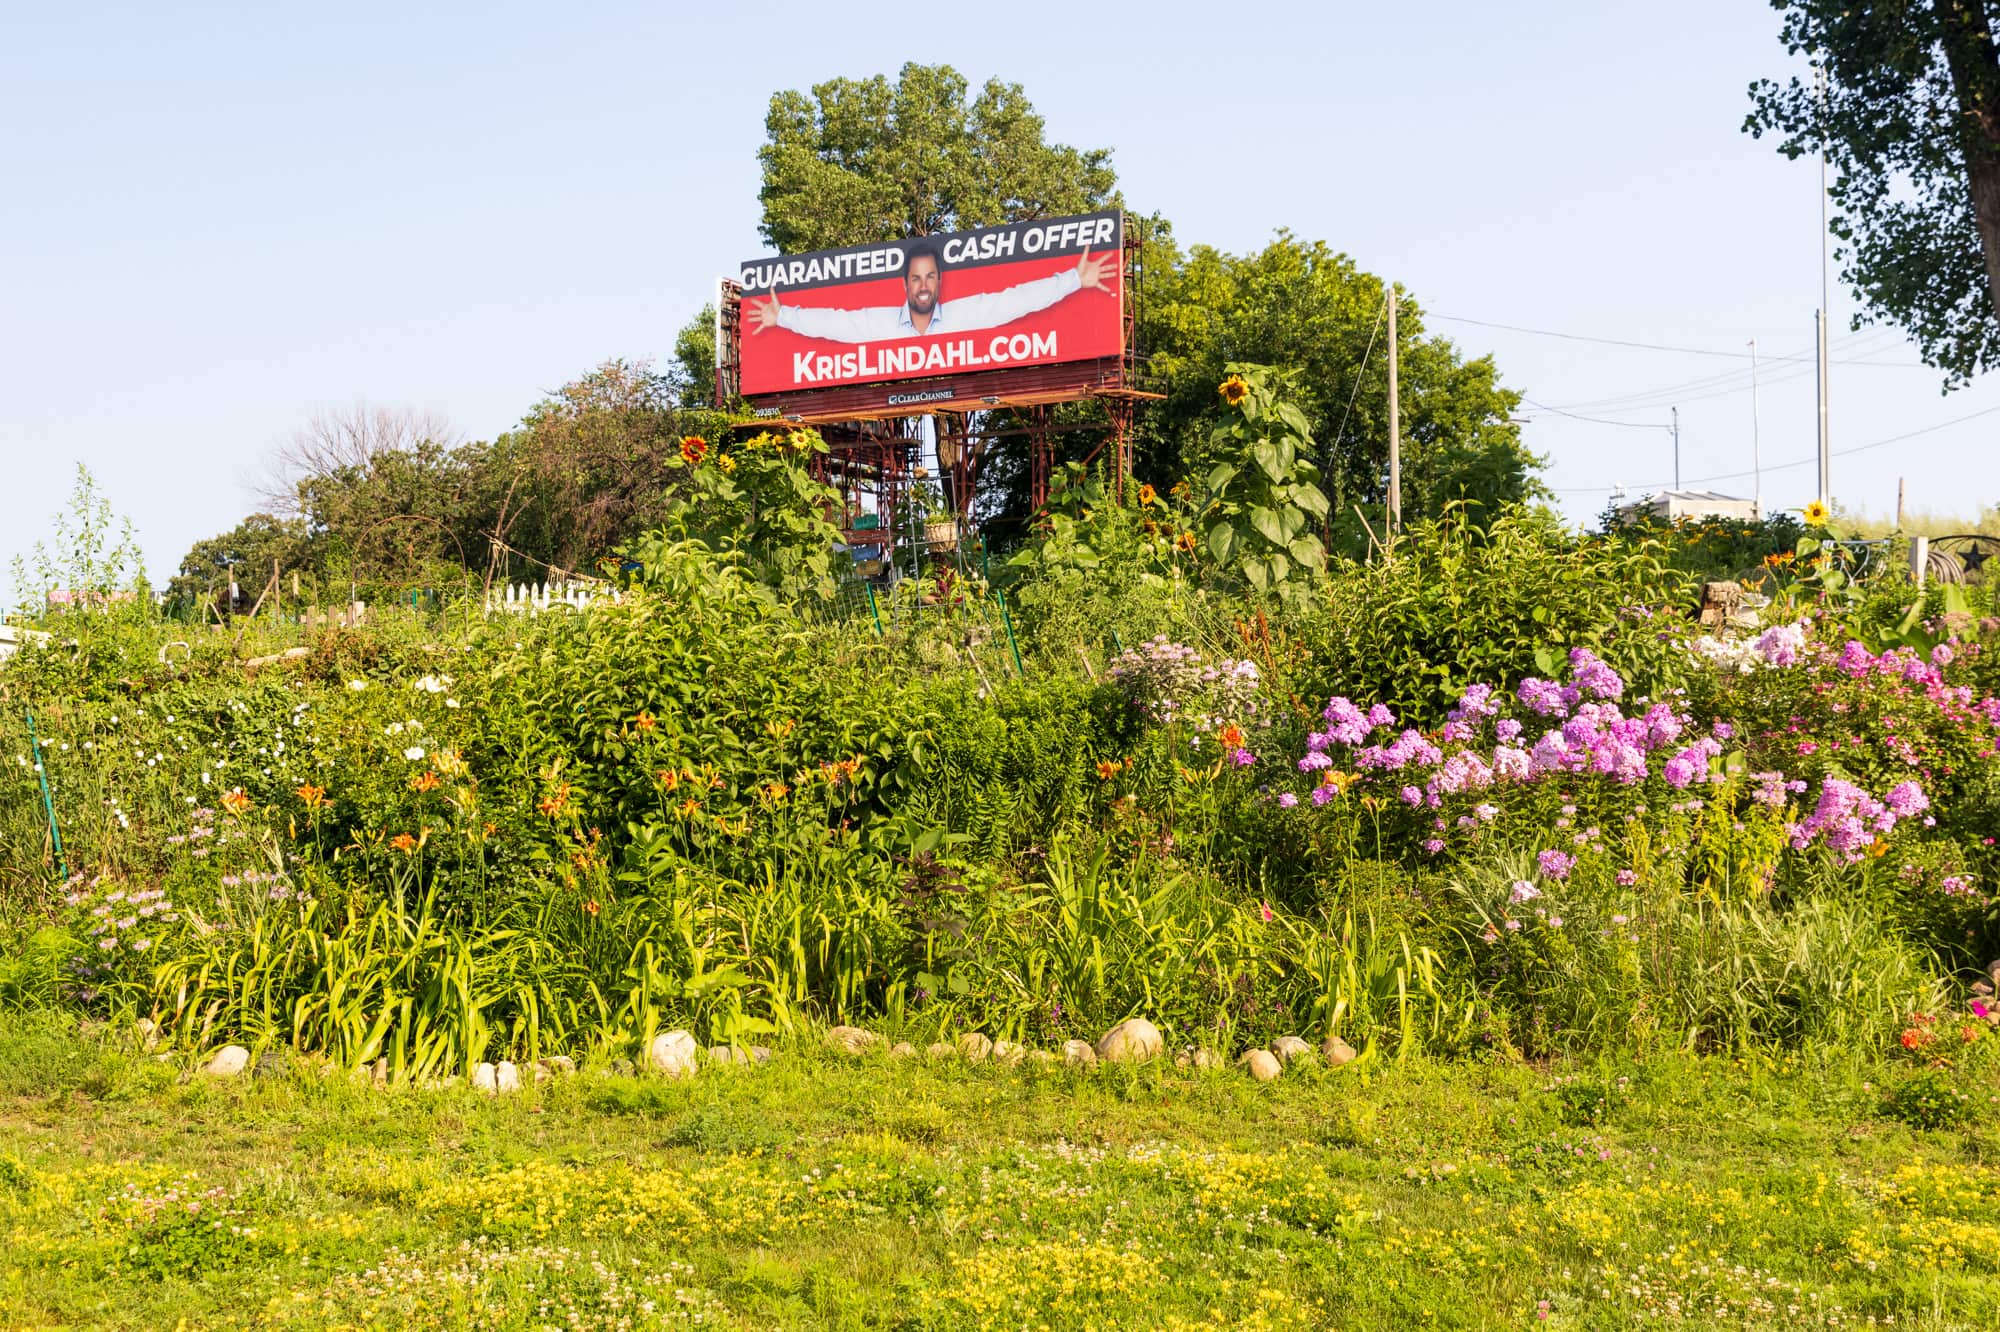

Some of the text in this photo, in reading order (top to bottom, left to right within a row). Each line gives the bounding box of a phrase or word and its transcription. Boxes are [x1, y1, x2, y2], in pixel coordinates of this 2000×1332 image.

[741, 218, 1115, 290] GUARANTEED CASH OFFER
[793, 330, 1057, 384] KRISLINDAHL.COM
